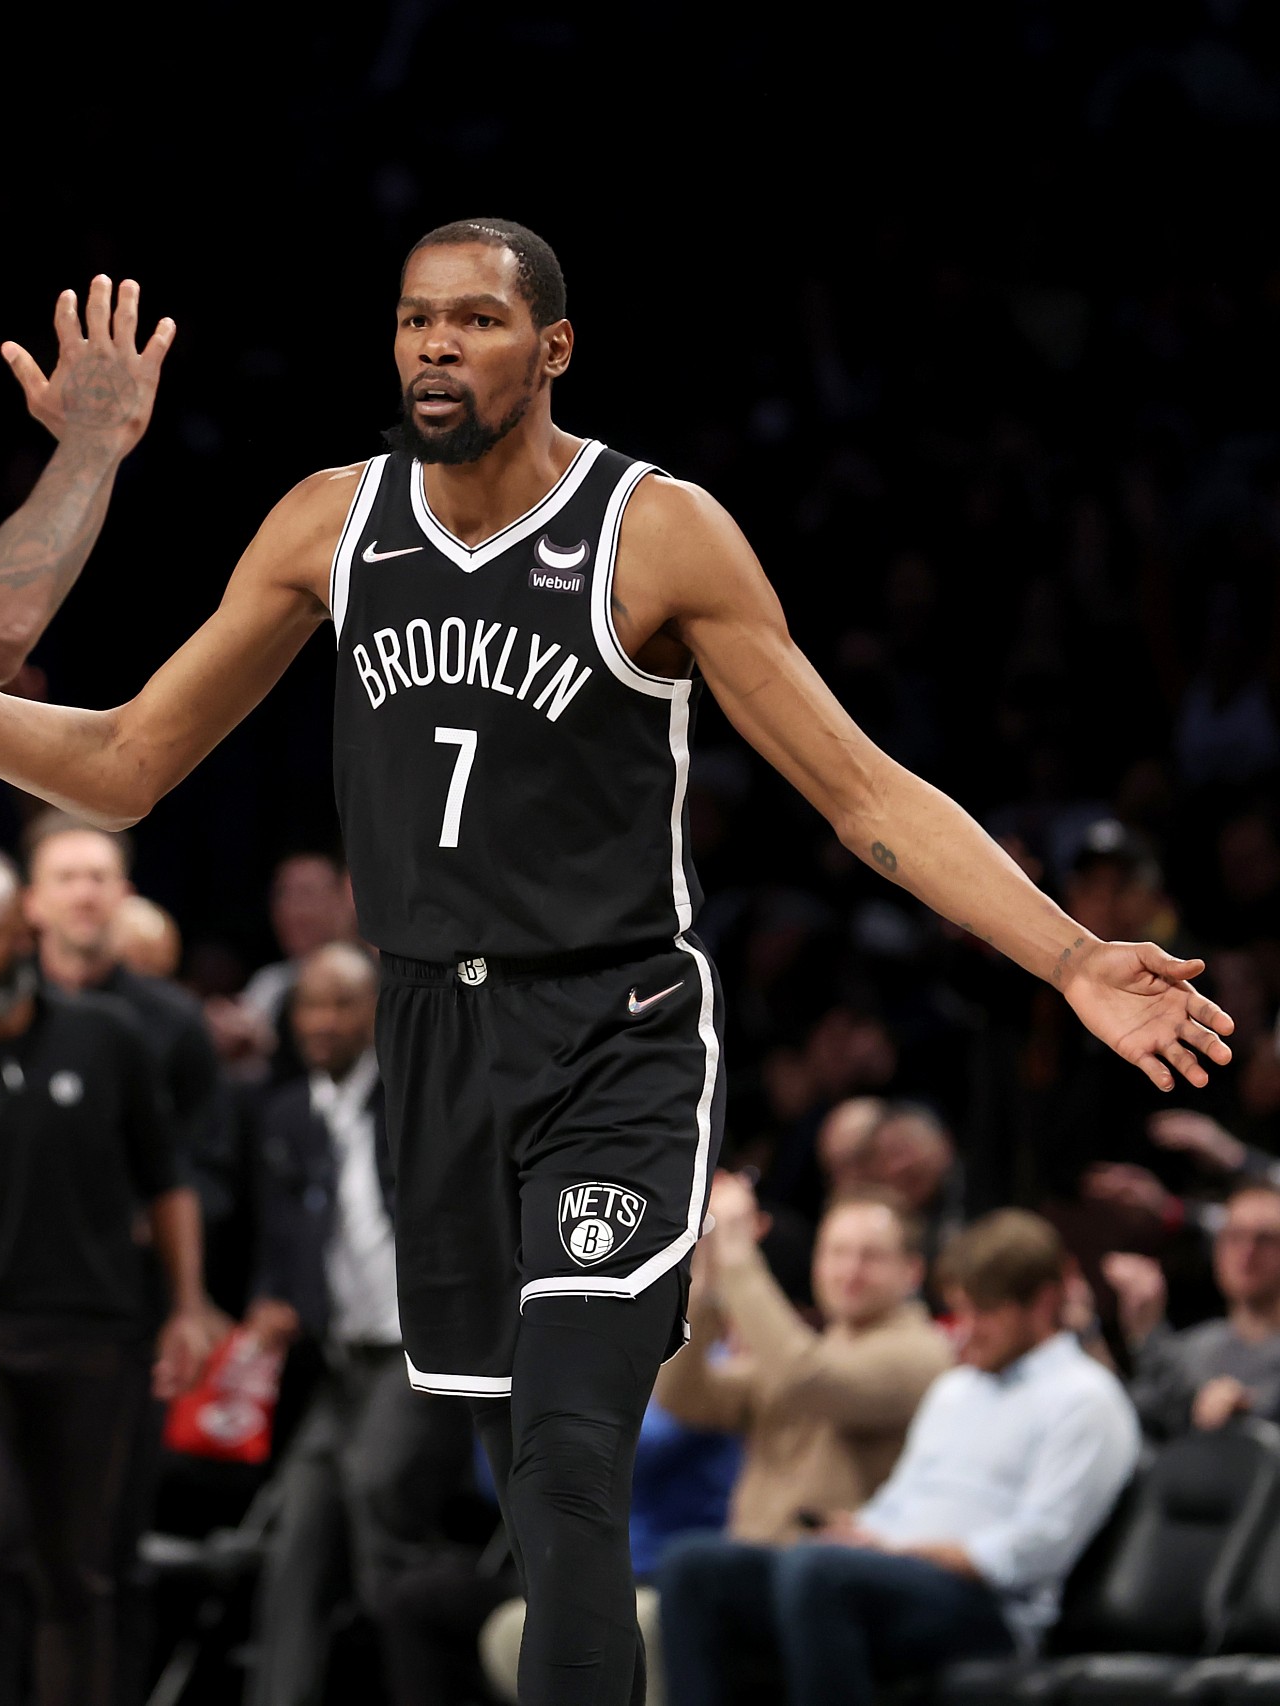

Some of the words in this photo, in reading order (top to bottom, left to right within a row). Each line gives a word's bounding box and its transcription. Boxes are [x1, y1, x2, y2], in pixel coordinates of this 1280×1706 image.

[533, 573, 581, 592] Webull
[352, 617, 593, 723] BROOKLYN
[434, 726, 478, 848] 7
[561, 1186, 639, 1228] NETS
[583, 1224, 599, 1254] B
